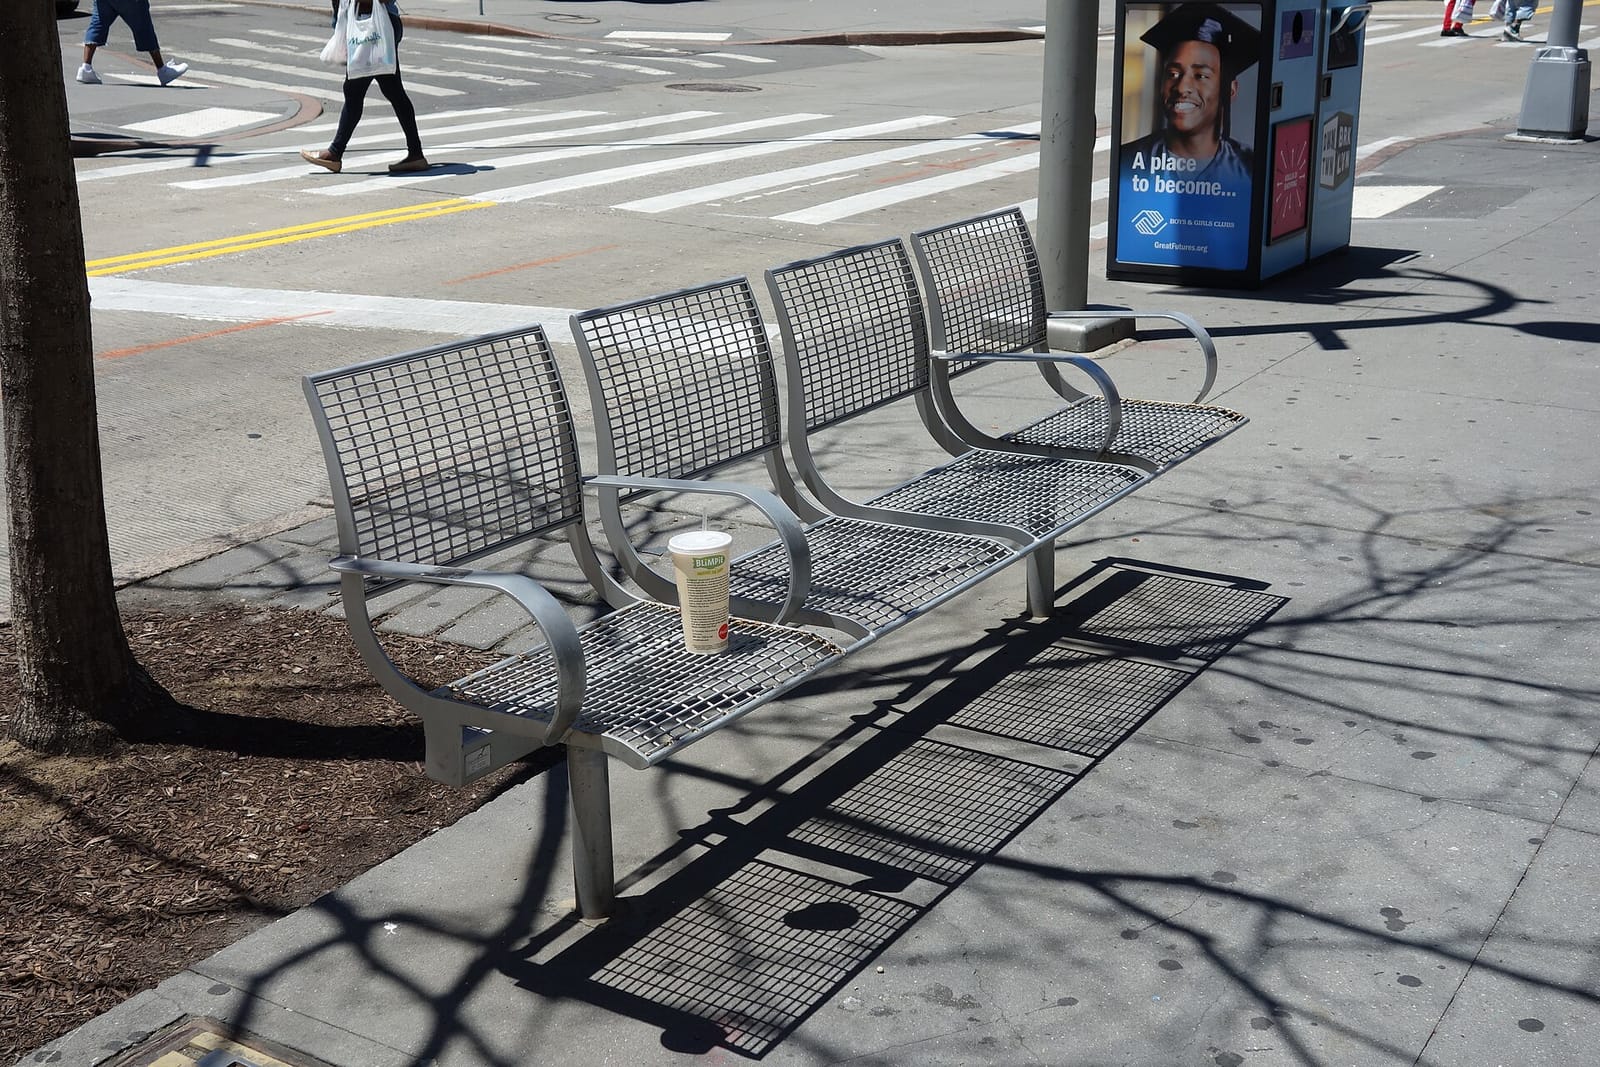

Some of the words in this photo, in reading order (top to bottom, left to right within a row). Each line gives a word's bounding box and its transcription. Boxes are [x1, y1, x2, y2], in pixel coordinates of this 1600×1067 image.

[1132, 151, 1146, 170] A
[1150, 152, 1196, 174] place
[1132, 174, 1150, 193] to
[1155, 174, 1236, 197] become...
[1170, 218, 1187, 226] BOYS
[1194, 219, 1213, 227] GIRLS
[1154, 241, 1208, 253] GreatFutures.org
